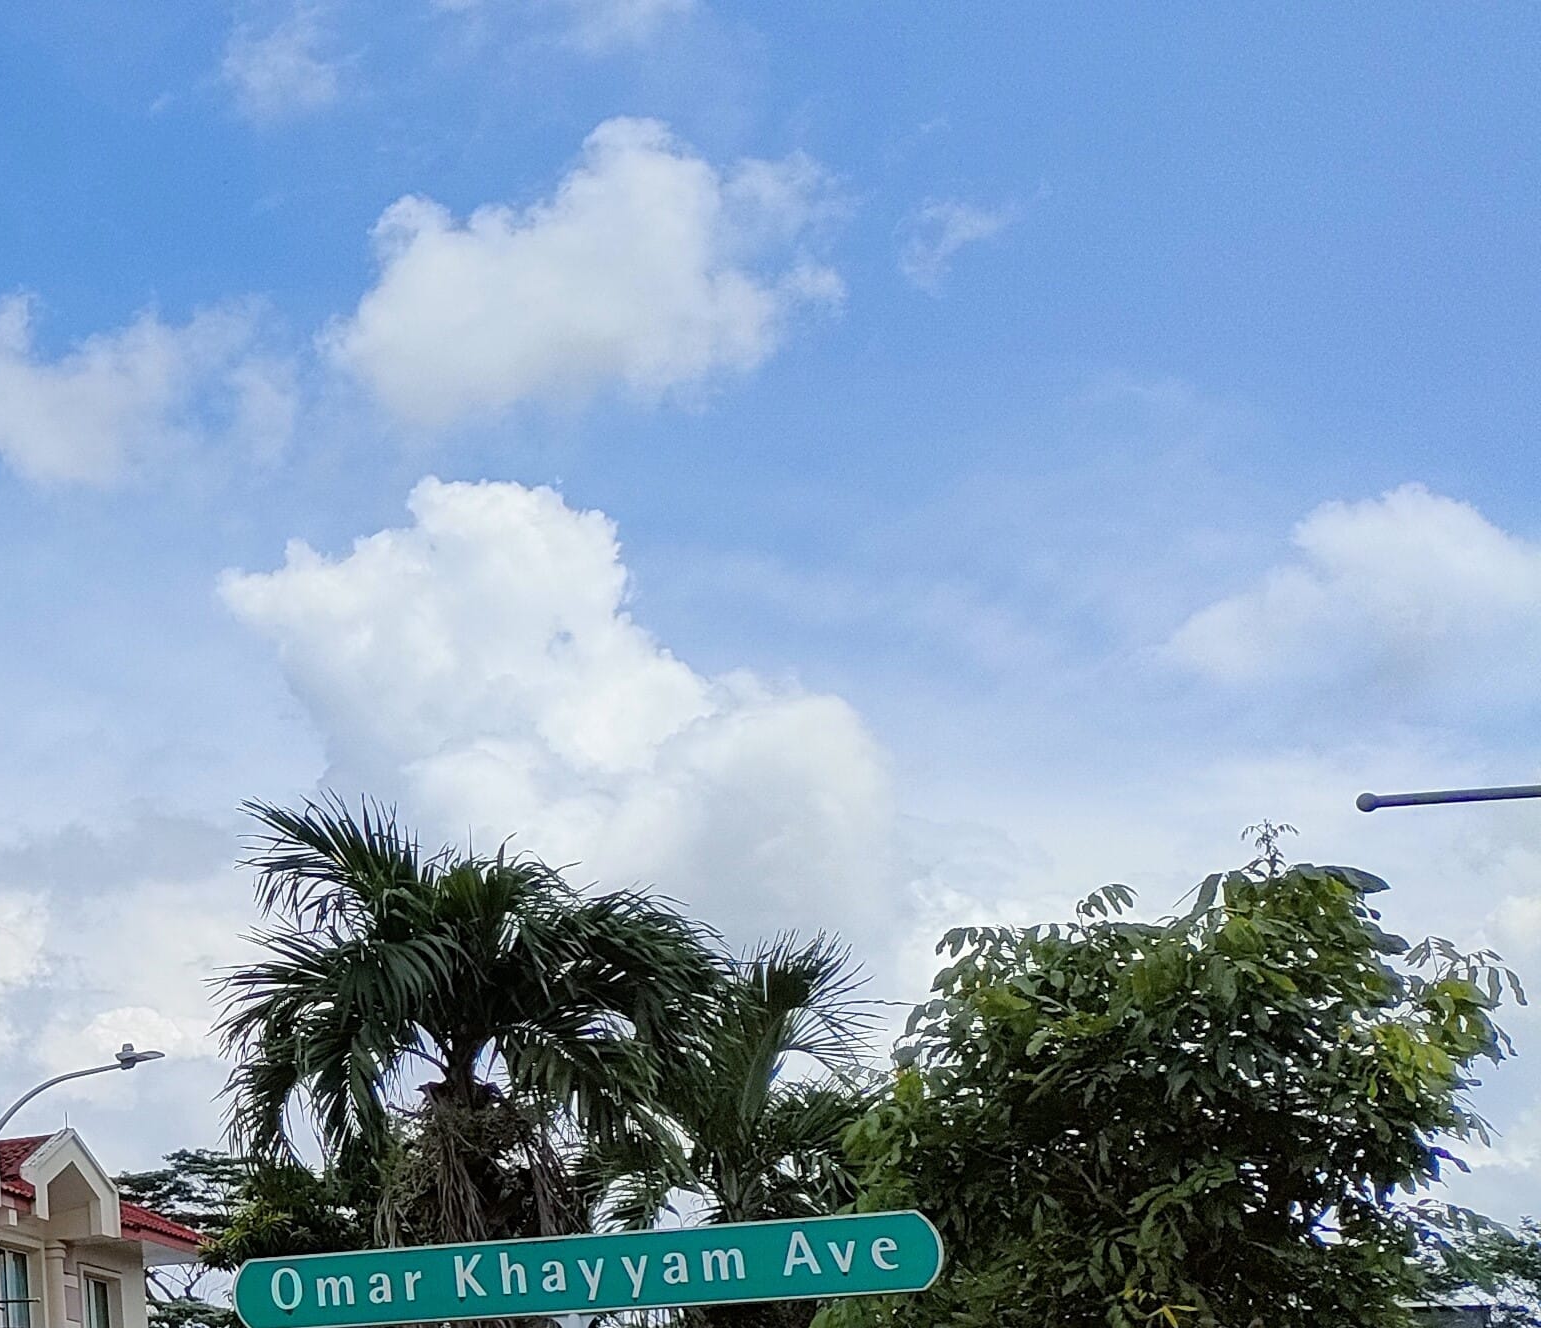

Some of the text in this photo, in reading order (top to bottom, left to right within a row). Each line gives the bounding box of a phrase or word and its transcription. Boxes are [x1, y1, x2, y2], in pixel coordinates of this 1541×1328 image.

[270, 1230, 900, 1311] Omar Khayyam Ave
